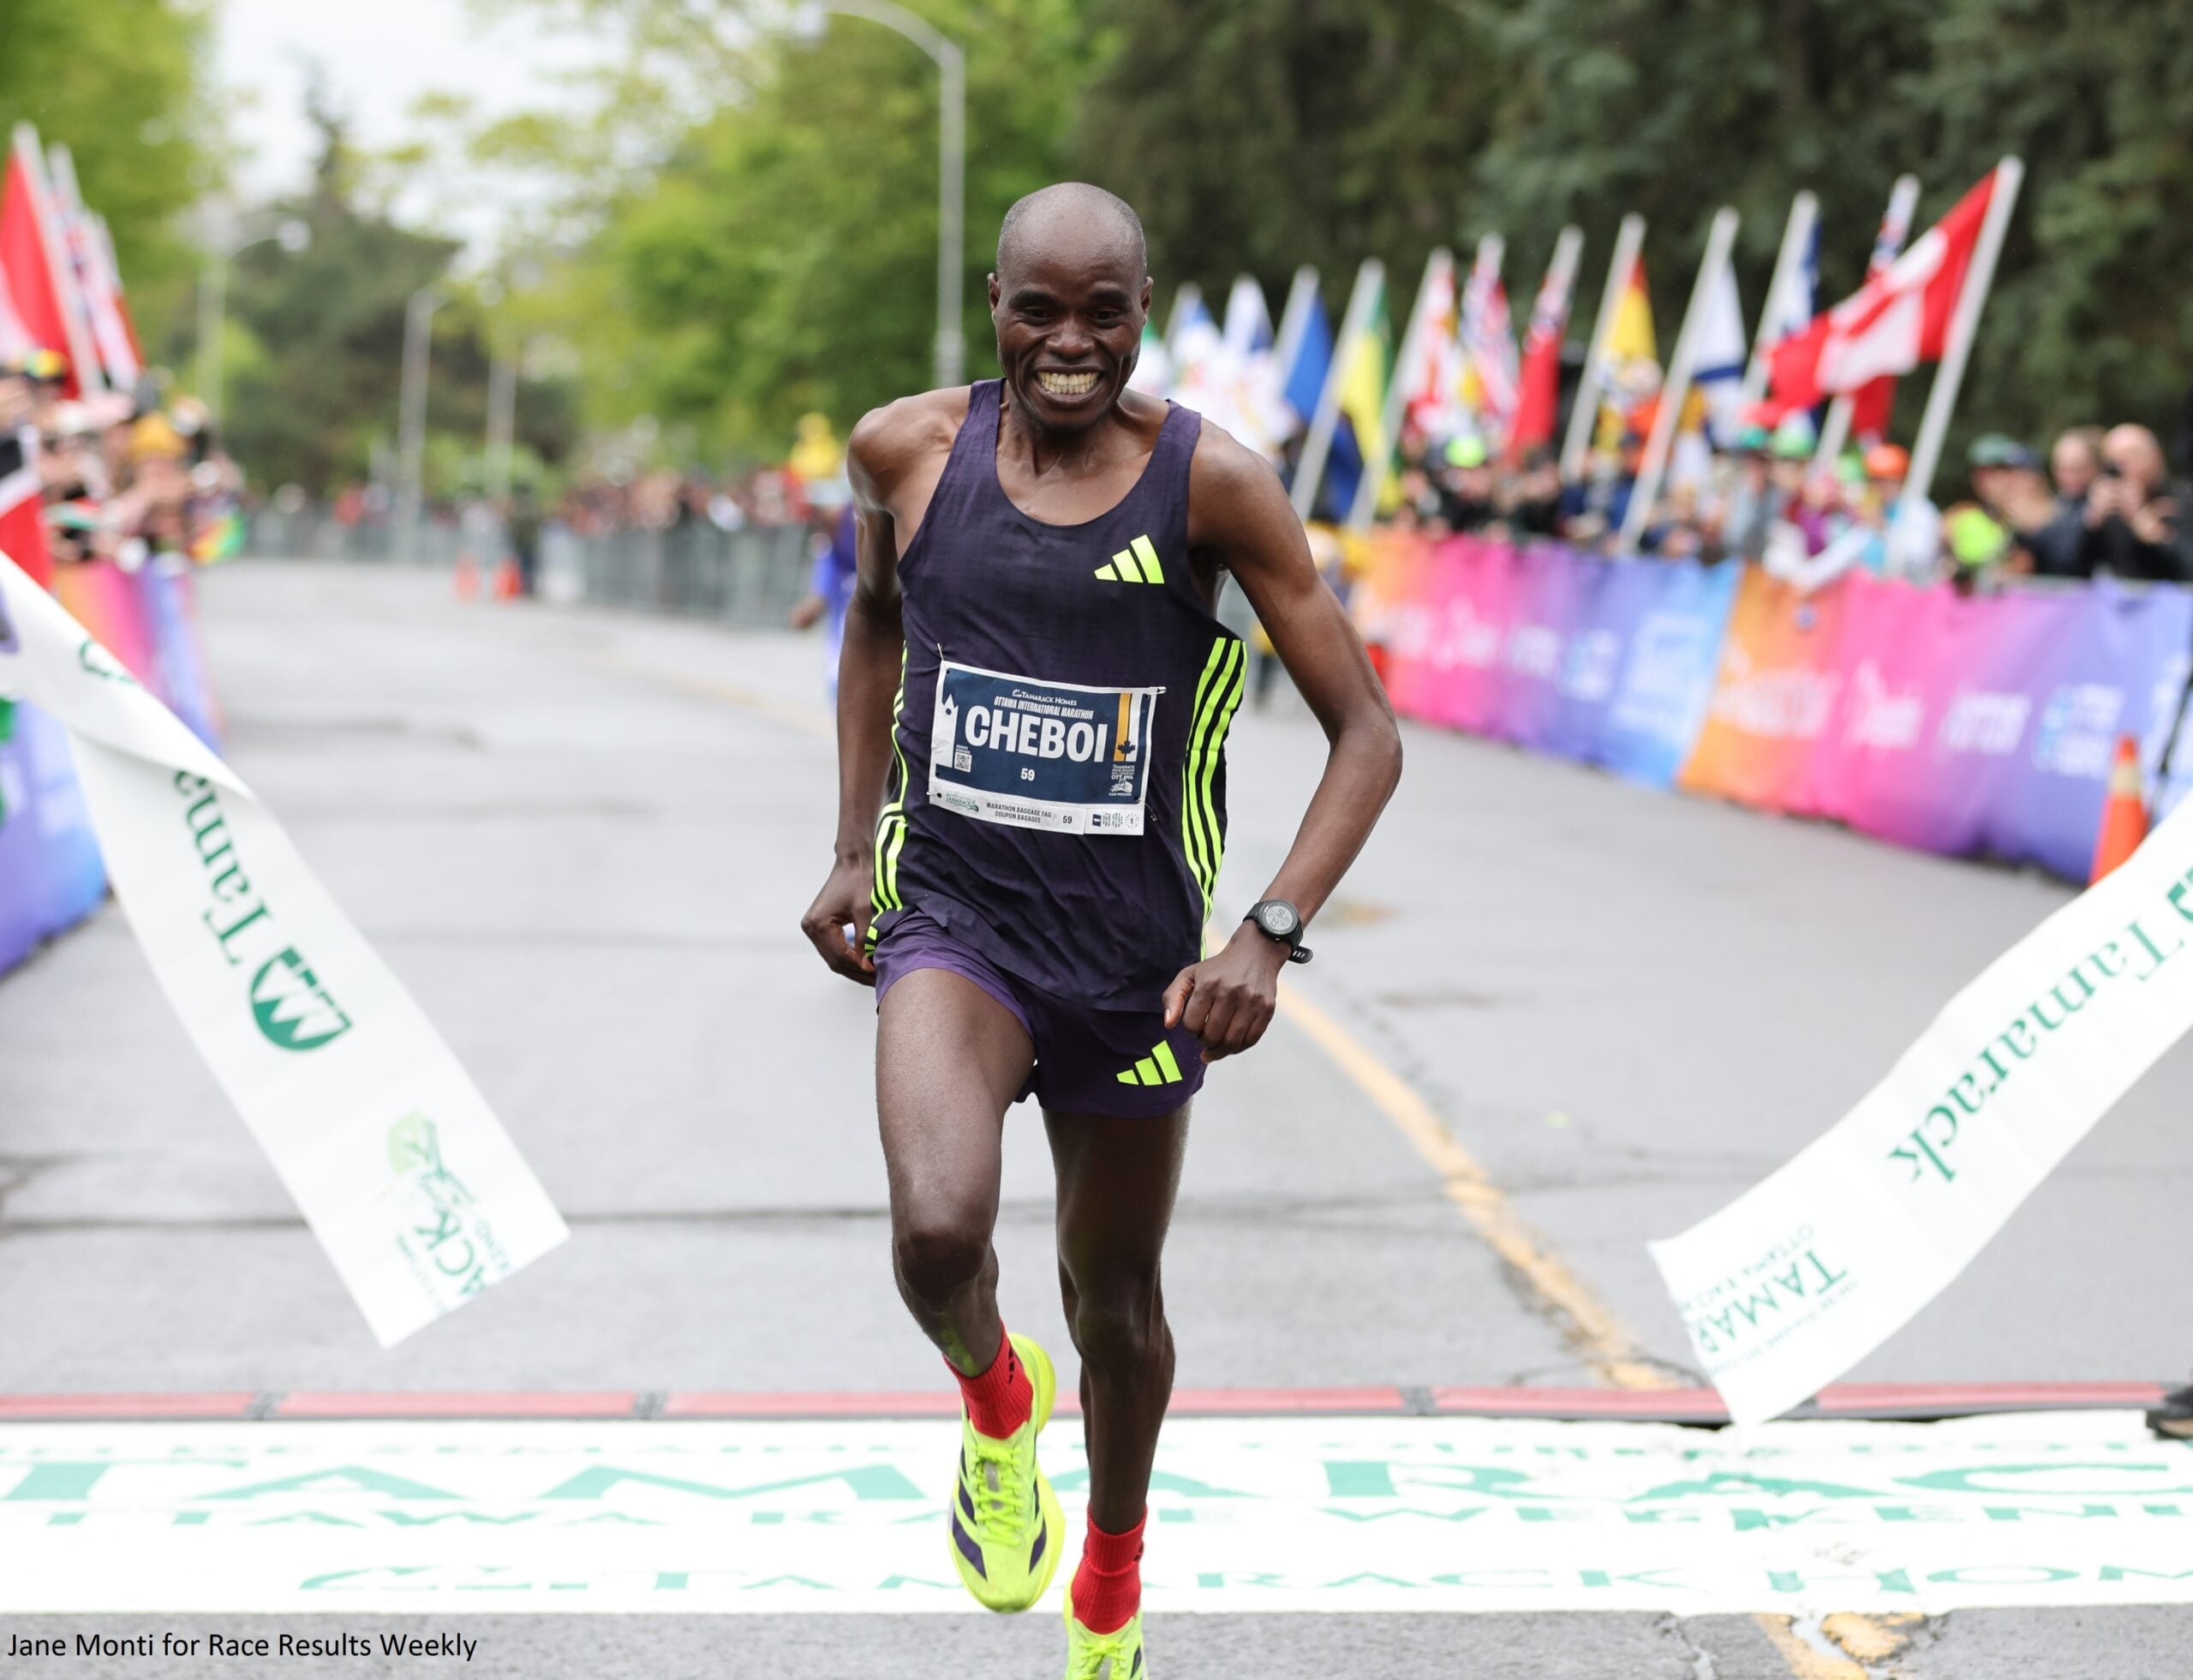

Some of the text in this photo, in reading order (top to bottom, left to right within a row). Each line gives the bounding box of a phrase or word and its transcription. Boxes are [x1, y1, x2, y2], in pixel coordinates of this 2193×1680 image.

[1021, 691, 1078, 706] TAMARACK HOMES
[994, 696, 1094, 720] OTTAWA INTERNATIONAL MARATHON
[965, 705, 1108, 762] CHEBOI
[1020, 768, 1036, 781] 59
[986, 802, 1016, 813] MARATHON
[1016, 806, 1041, 816] BAGGAGE
[995, 811, 1041, 823] COUPON BAGAGES
[1062, 816, 1073, 824] 59
[1888, 916, 2187, 1182] Tamarack
